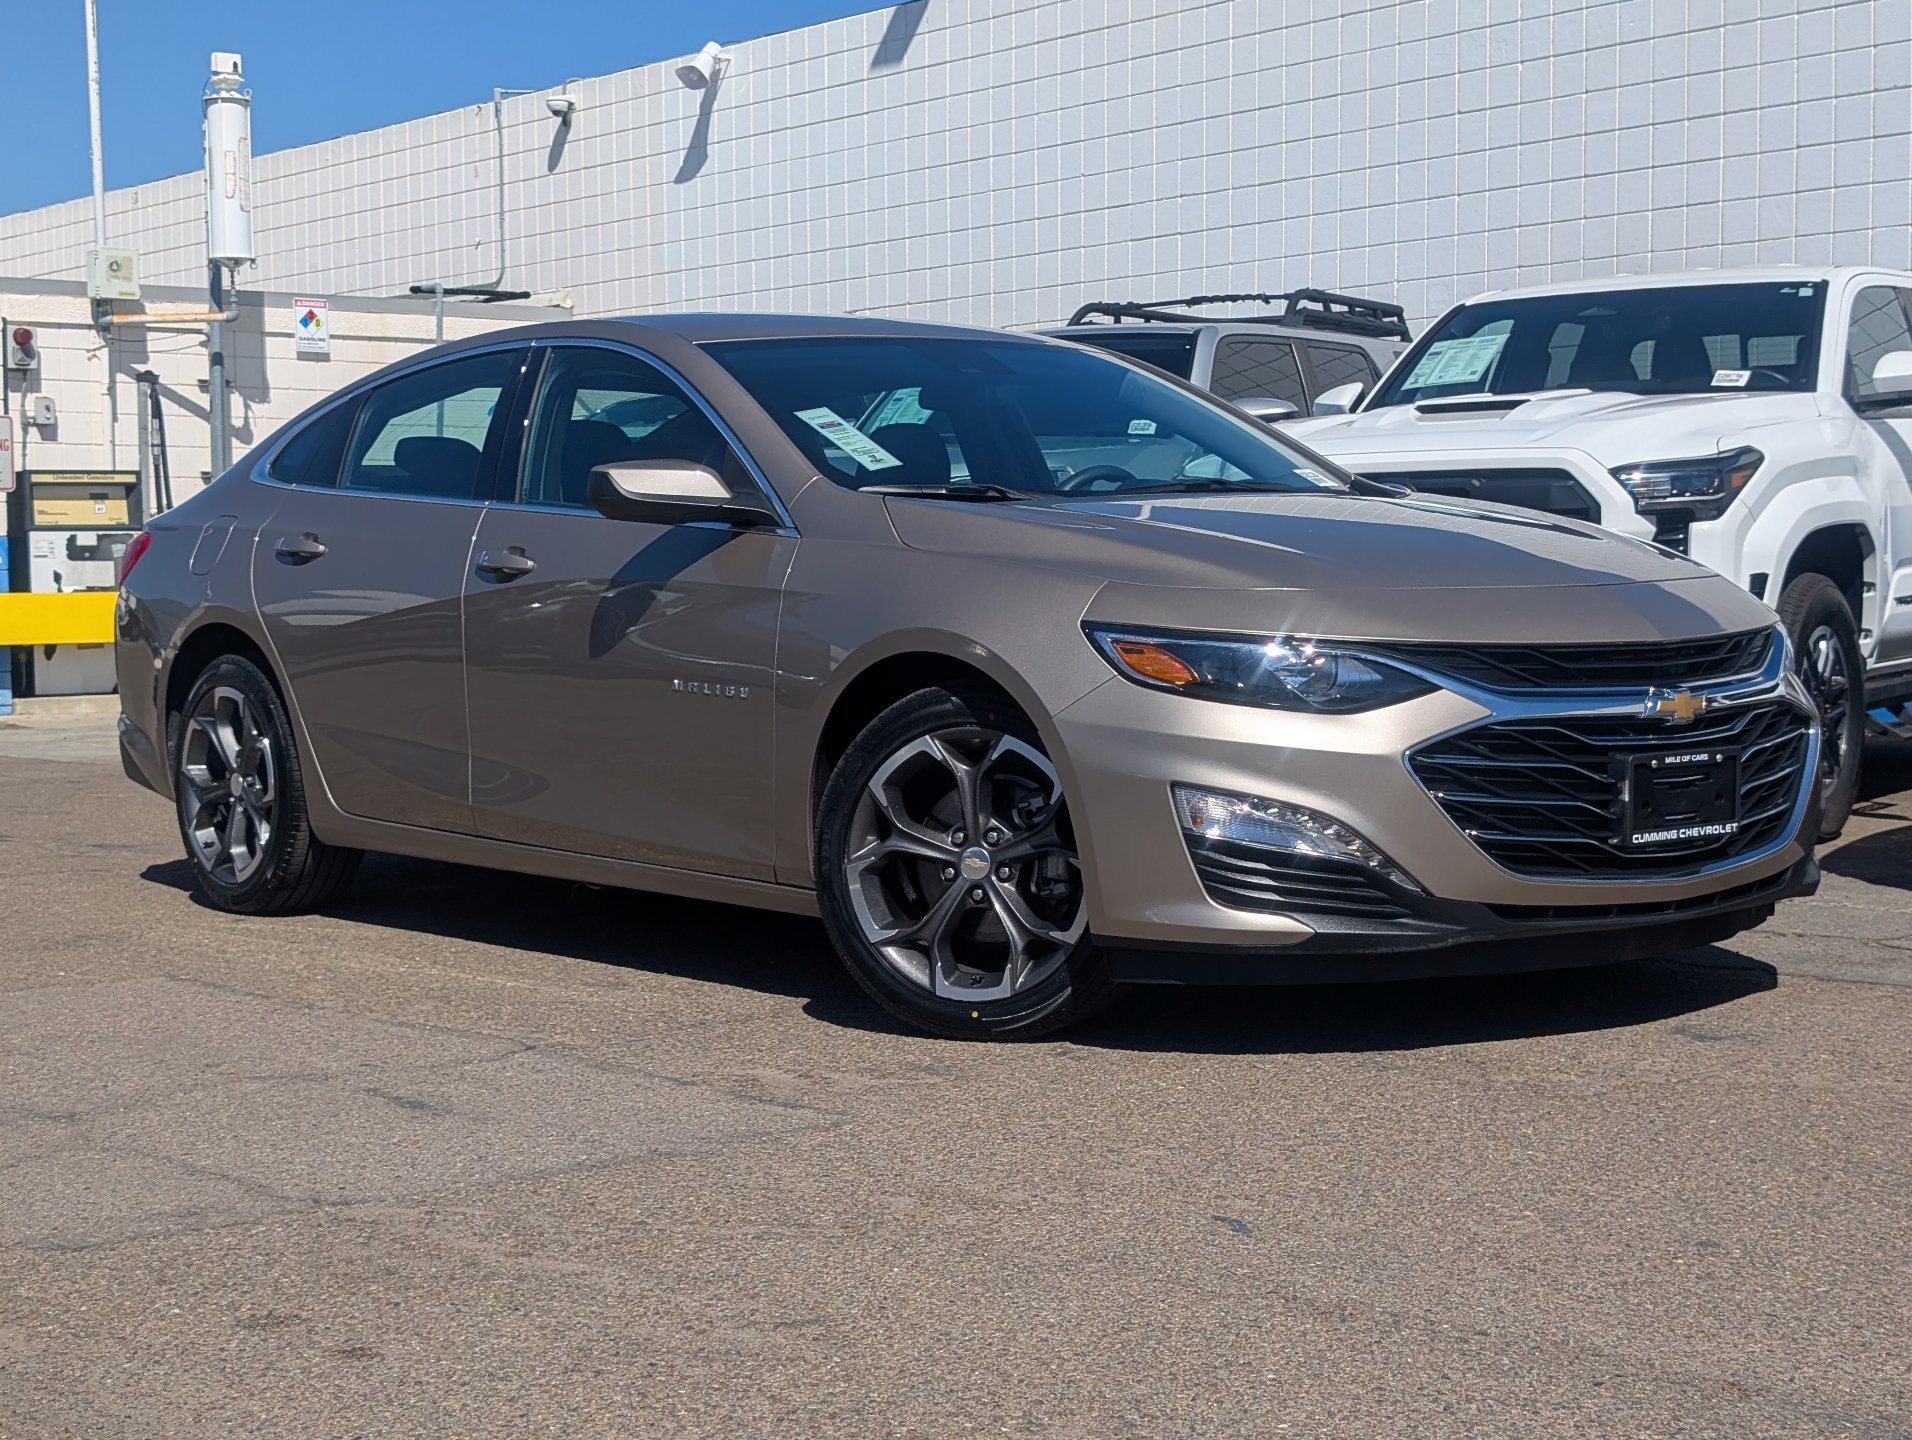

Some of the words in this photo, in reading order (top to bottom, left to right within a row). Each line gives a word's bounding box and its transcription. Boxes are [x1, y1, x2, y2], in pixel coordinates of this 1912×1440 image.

[672, 679, 749, 699] MALIBU
[1665, 755, 1681, 764] MILE
[1692, 753, 1709, 762] CARS
[1632, 830, 1678, 844] CUMMING
[1679, 822, 1739, 838] CHEVROLET
